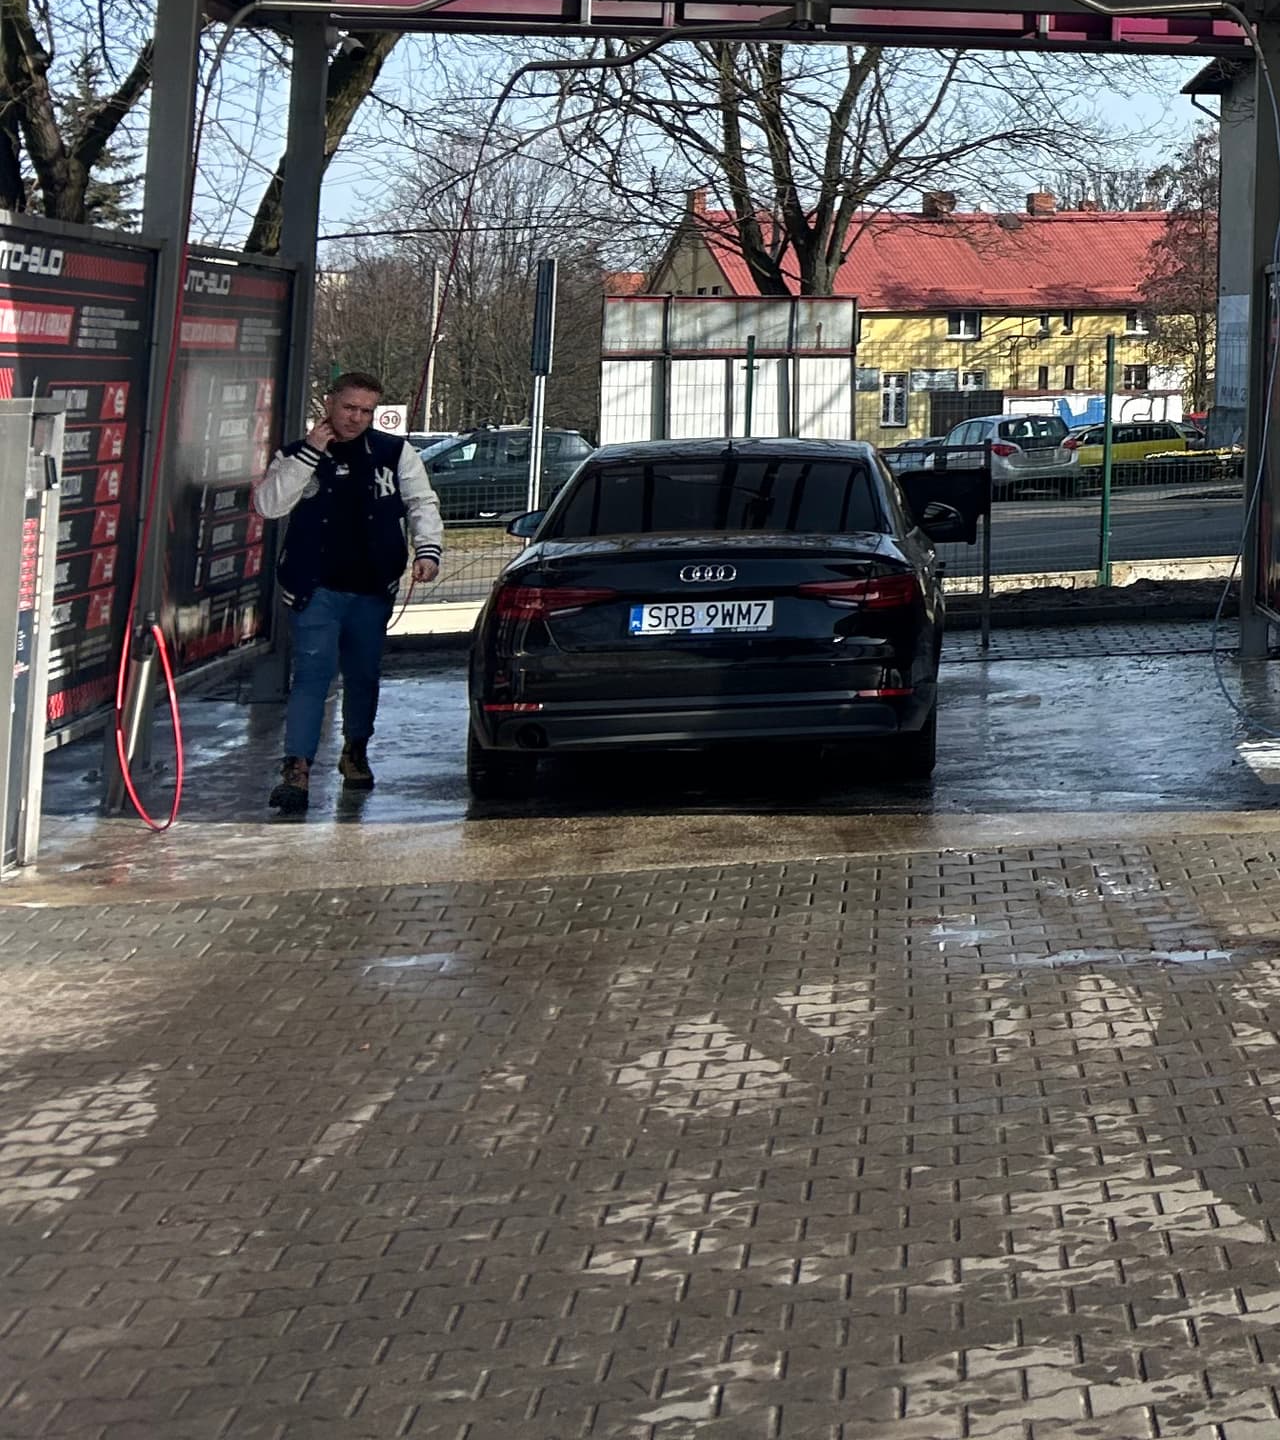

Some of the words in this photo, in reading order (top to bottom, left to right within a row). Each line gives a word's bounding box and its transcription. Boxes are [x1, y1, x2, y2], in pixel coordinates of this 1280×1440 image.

[383, 415, 399, 426] 30
[648, 604, 695, 628] SRB
[705, 602, 767, 627] 9WM7
